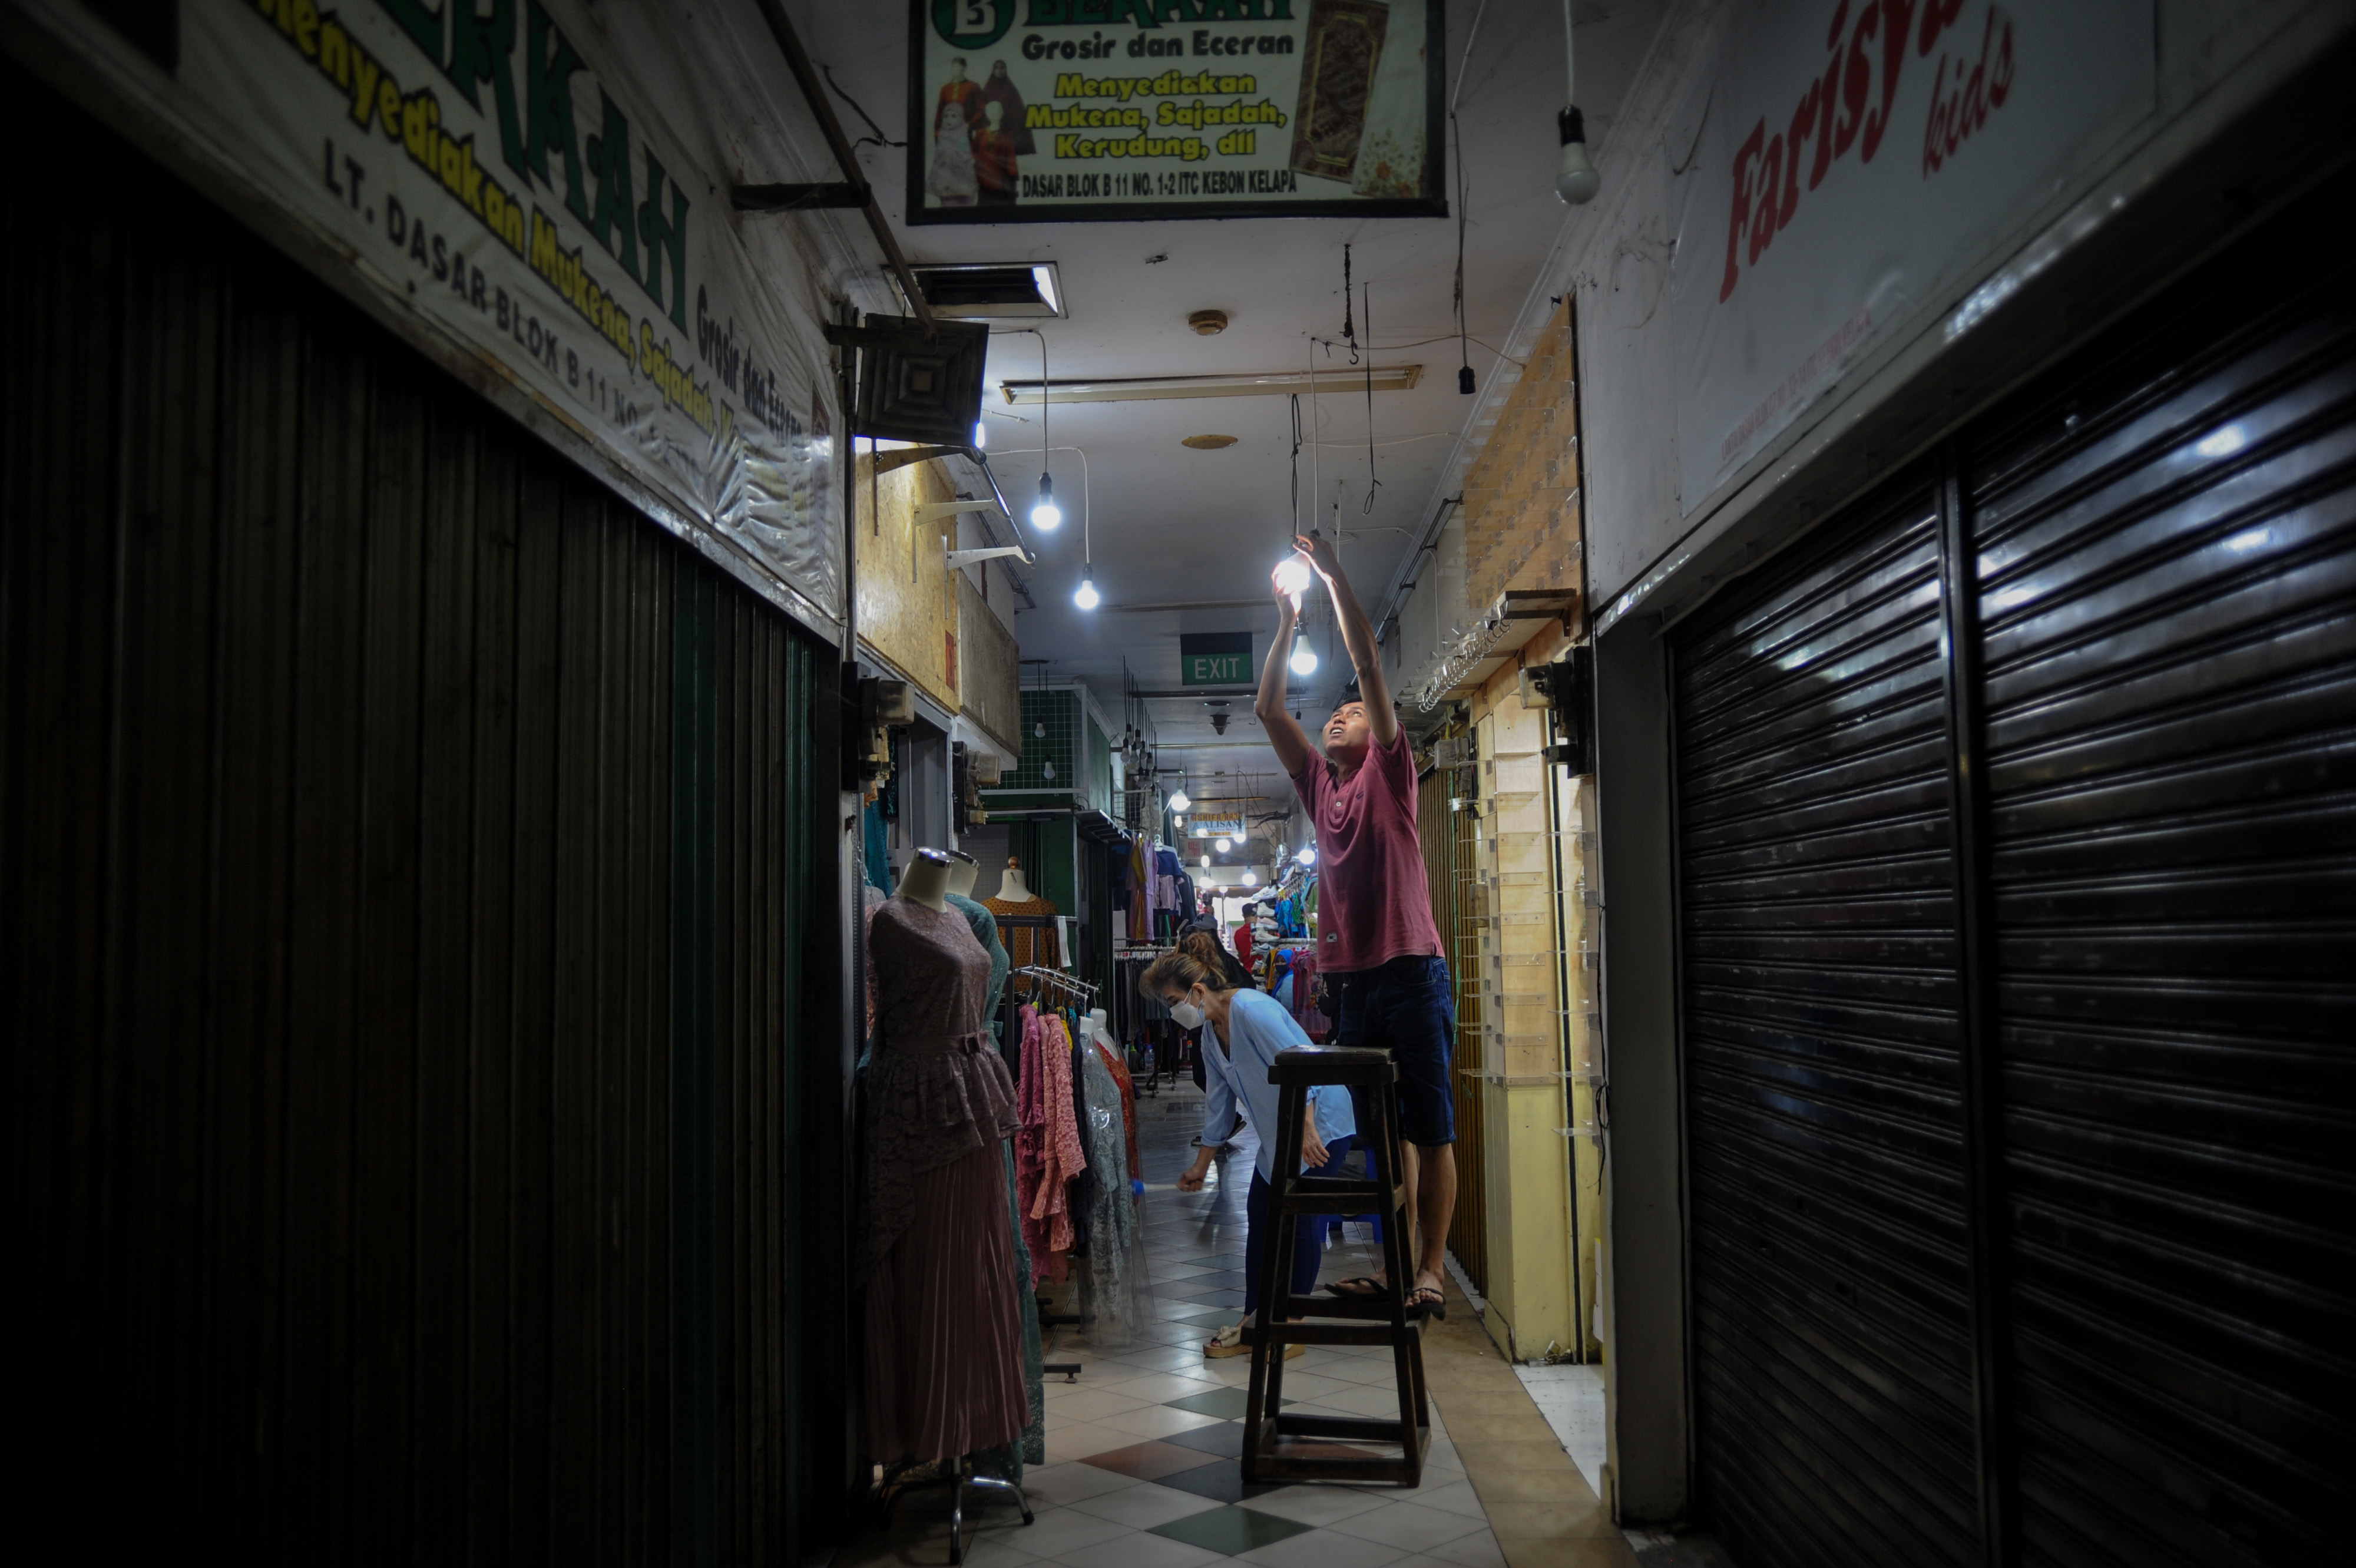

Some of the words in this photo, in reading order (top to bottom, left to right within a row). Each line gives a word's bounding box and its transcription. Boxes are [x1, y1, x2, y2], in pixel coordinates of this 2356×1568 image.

[1022, 31, 1116, 60] Grosir
[1127, 31, 1183, 57] dan
[1193, 29, 1293, 56] Eceran
[1054, 69, 1256, 102] Menyediakan
[1923, 4, 2015, 181] kids
[1025, 102, 1150, 131] Mukena,
[1156, 98, 1287, 131] Sajadah,
[1055, 131, 1210, 161] Kerudung,
[1217, 128, 1255, 156] dll
[1023, 174, 1063, 198] DASAR
[1067, 173, 1100, 197] BLOK
[1103, 173, 1111, 196] B
[1116, 173, 1127, 196] 11
[1133, 173, 1154, 196] NO.
[1158, 172, 1175, 196] 1-2
[1179, 171, 1198, 194] ITC
[1203, 170, 1245, 194] KEBON
[1249, 169, 1297, 193] KELAPA
[325, 137, 375, 225] LT.
[387, 193, 487, 314] DASAR
[496, 286, 560, 374] BLOK
[567, 347, 579, 389] B
[530, 202, 636, 377] Mukena,
[697, 283, 739, 395] Grosir
[1194, 657, 1240, 680] EXIT
